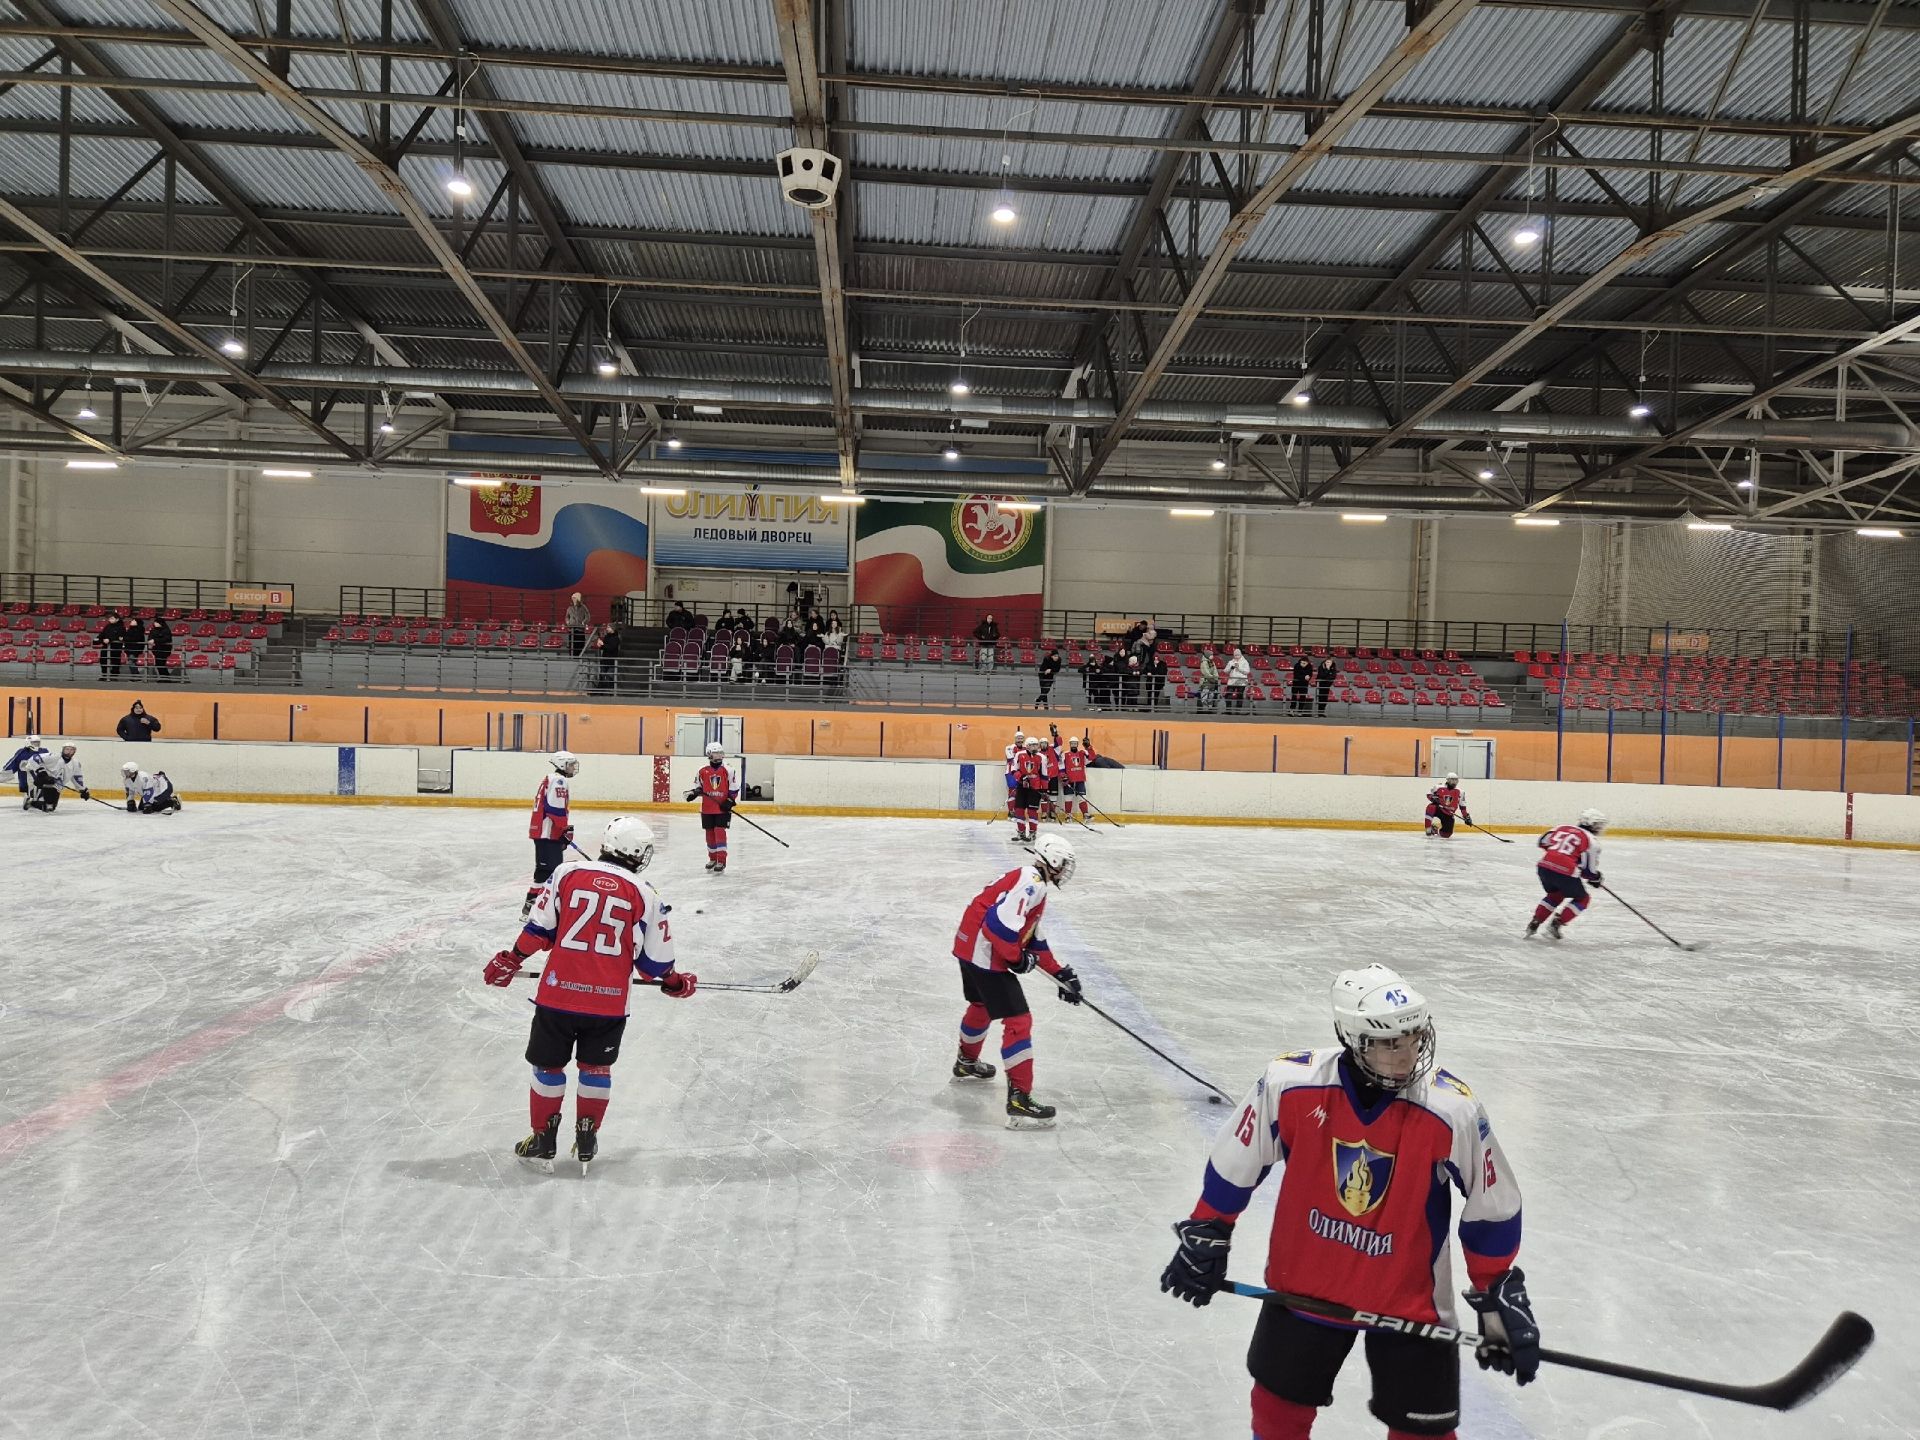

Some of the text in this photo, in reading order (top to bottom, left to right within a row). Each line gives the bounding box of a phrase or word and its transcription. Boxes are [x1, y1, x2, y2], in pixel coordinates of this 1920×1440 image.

[693, 526, 812, 544] ЛЕДОВЫЙ ДВОРЕЦ
[233, 592, 267, 601] СЕКТОР
[560, 888, 632, 957] 25
[1385, 988, 1408, 1006] 15
[1234, 1103, 1257, 1147] 15
[1483, 1148, 1497, 1194] 15
[1308, 1207, 1393, 1257] ОЛИМПИЯ
